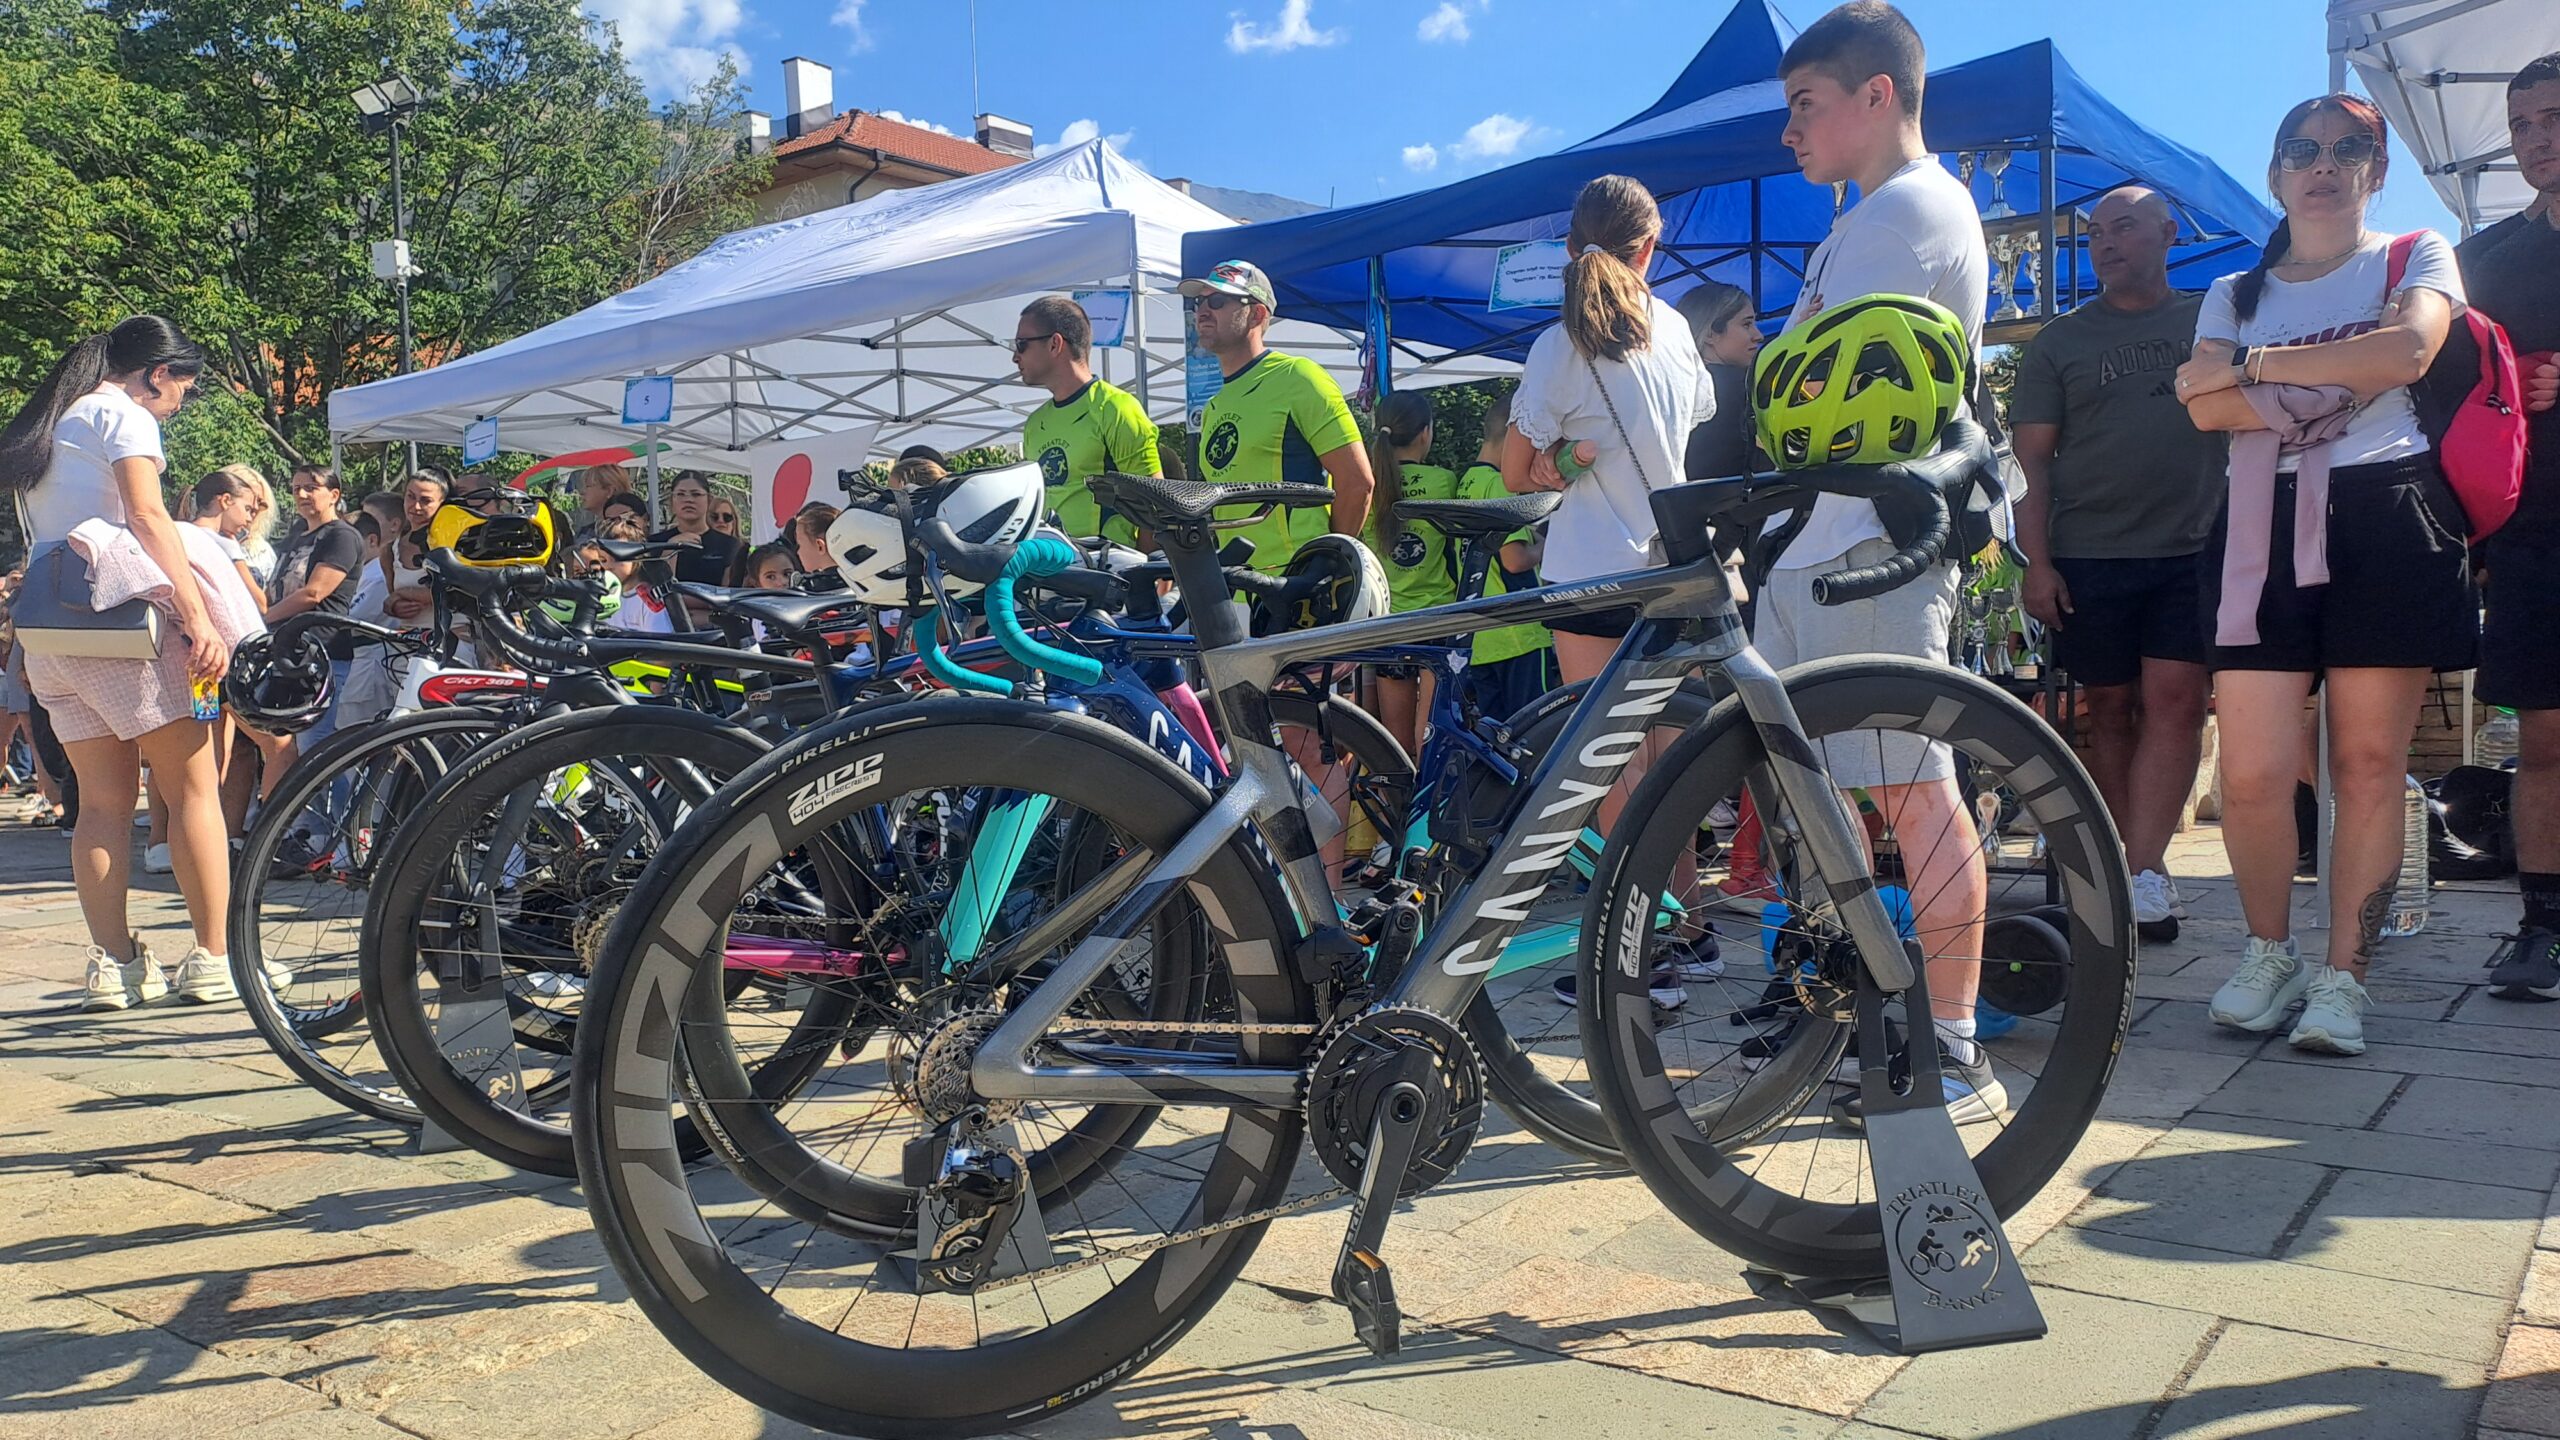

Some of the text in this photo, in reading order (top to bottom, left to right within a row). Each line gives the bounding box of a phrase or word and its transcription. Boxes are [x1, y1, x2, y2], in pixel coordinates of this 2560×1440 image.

[2099, 339, 2193, 387] ADID
[643, 395, 650, 405] 5
[1541, 589, 1584, 604] AEROAD
[467, 738, 526, 778] PIRELLI
[781, 726, 871, 775] PIRELLI
[786, 752, 885, 813] ZIPP
[793, 773, 877, 820] 404 FIRECREST
[1442, 676, 1687, 977] CANYON
[1594, 889, 1614, 972] PIRELLI
[1617, 883, 1640, 976] ZIPP
[1629, 945, 1640, 975] 404
[2117, 976, 2133, 1033] ZERO
[1740, 1085, 1811, 1143] CONTINENTAL
[1885, 1180, 1986, 1218] TRIATLET
[1921, 1288, 2006, 1312] BANYA
[1073, 1358, 1133, 1398] ZERO
